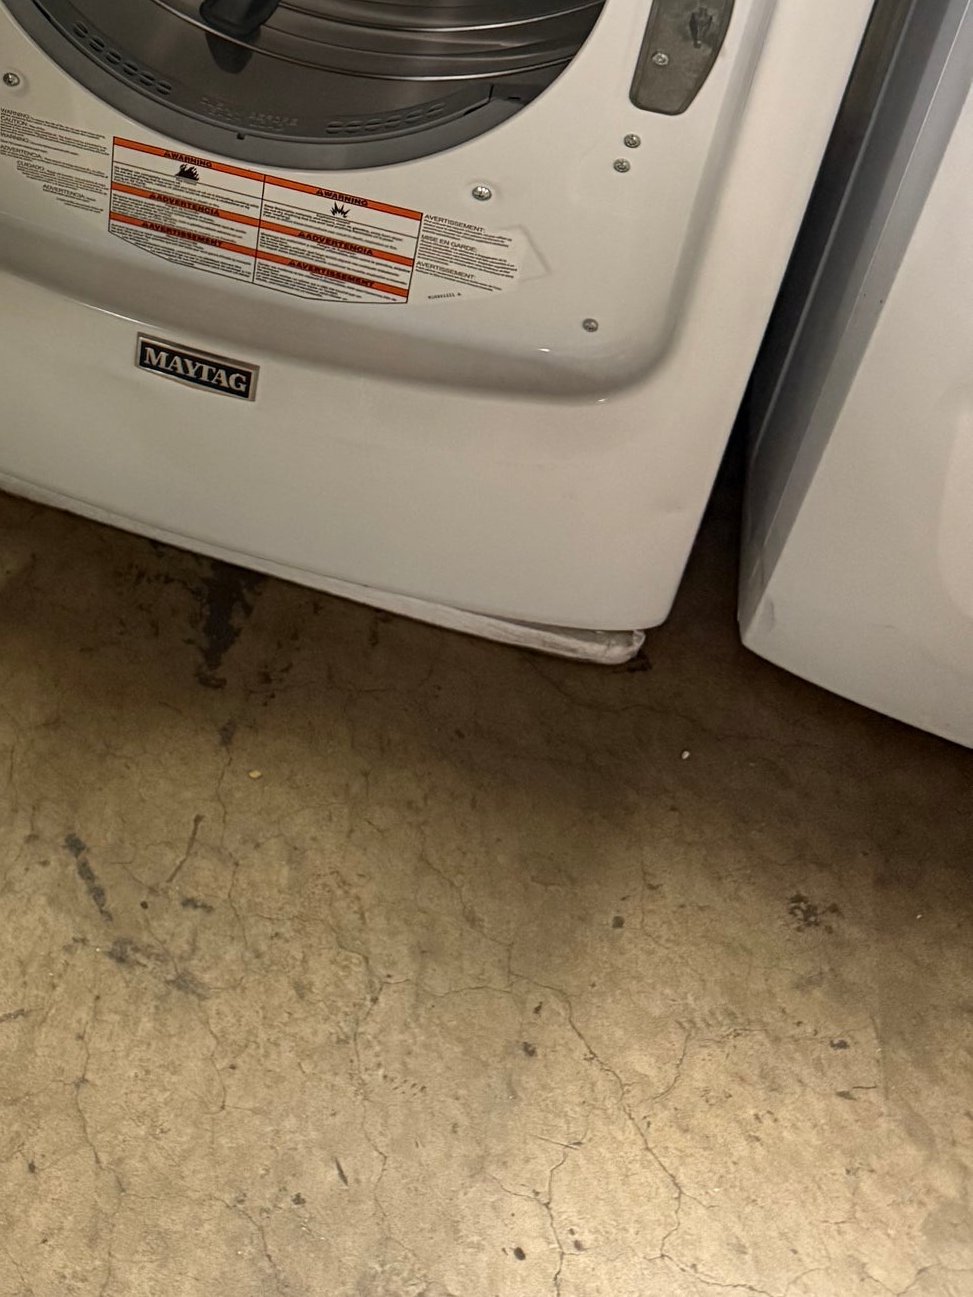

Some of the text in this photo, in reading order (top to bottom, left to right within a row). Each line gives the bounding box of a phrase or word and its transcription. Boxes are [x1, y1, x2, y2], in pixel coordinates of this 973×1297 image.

[168, 152, 212, 169] WARNING
[155, 194, 220, 217] ADVERTENCIA
[323, 190, 369, 208] WARNING
[148, 222, 223, 248] AVERTISSEMENT
[424, 214, 486, 233] AVERTISSEMENT:
[305, 233, 373, 257] ADVERTENCIA
[439, 238, 450, 246] EN
[296, 261, 375, 288] AVERTISSEMENT
[143, 346, 248, 393] MAYTAG
